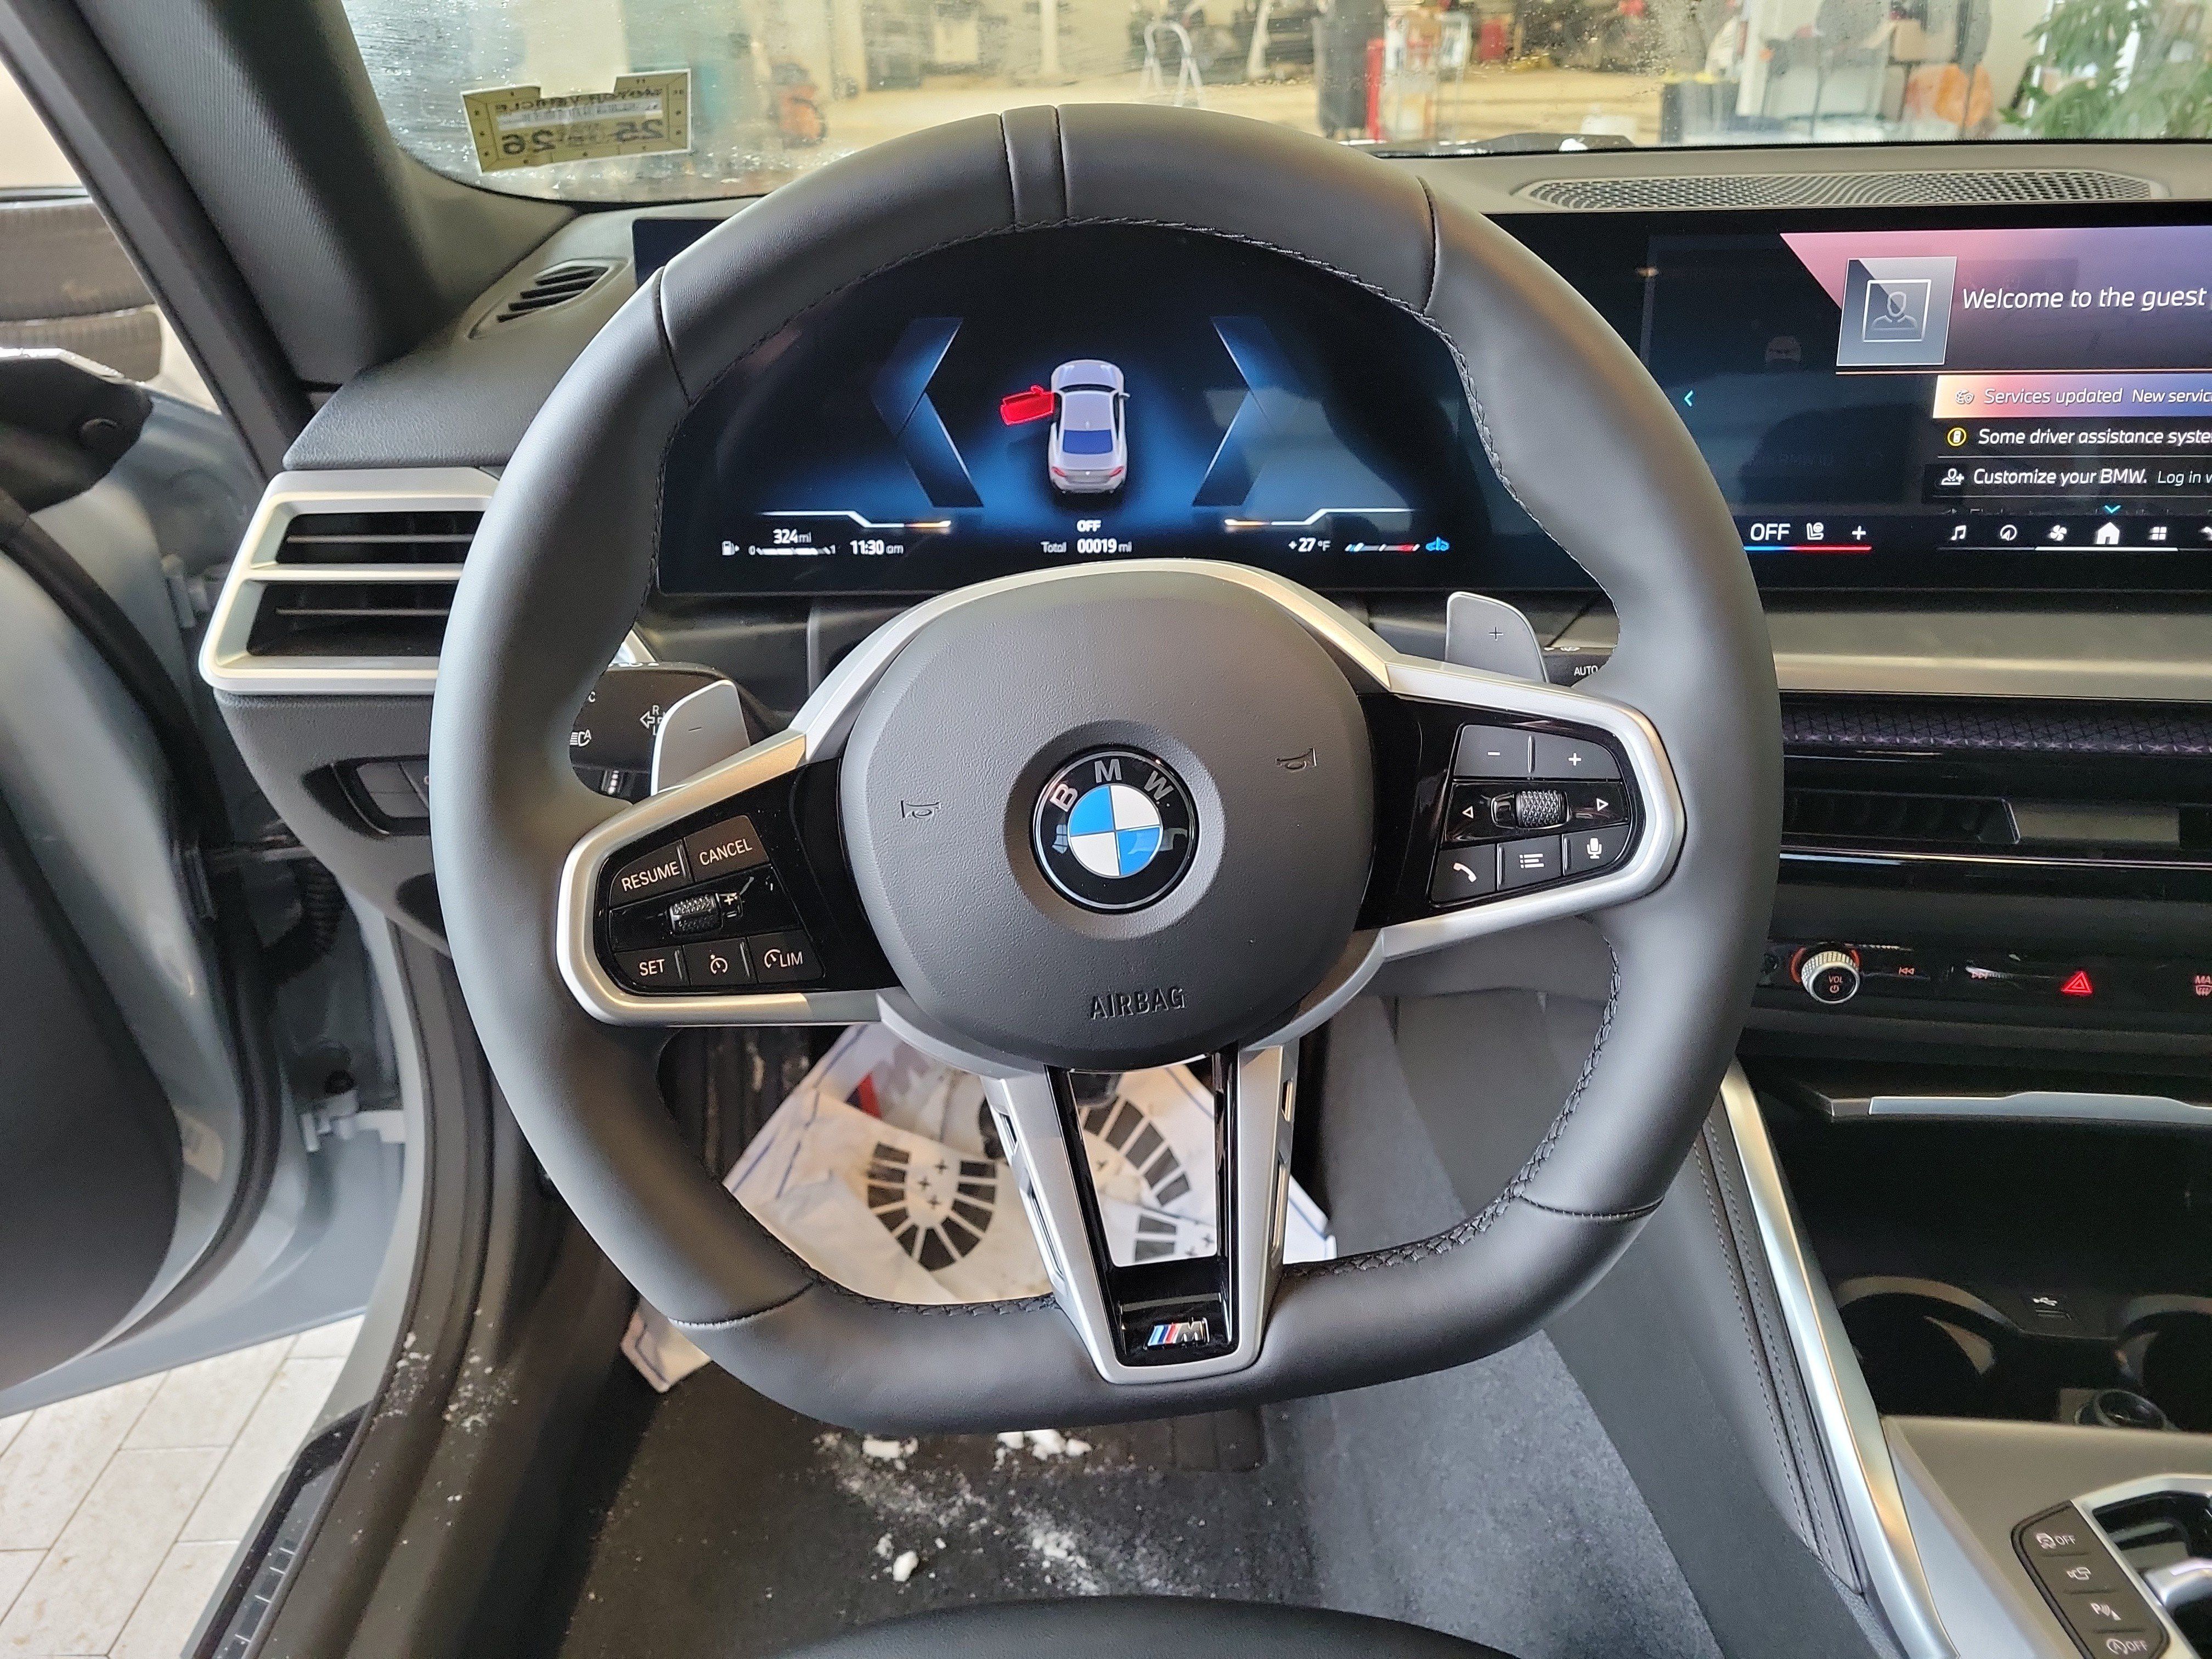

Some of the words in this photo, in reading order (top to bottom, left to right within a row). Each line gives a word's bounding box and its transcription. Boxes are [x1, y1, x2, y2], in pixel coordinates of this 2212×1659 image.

[1962, 288, 2063, 309] Welcome
[2070, 289, 2092, 308] to
[2099, 286, 2135, 307] the
[2141, 287, 2208, 312] guest
[1984, 388, 2051, 404] Services
[2056, 388, 2123, 407] updated
[2132, 389, 2165, 403] New
[2168, 388, 2212, 403] servic
[1978, 428, 2024, 444] Some
[2030, 428, 2075, 444] driver
[2078, 428, 2163, 444] assistance
[2167, 429, 2212, 447] syste
[1974, 468, 2056, 485] Customize
[2060, 471, 2097, 487] your
[2101, 469, 2147, 484] BMW.
[2158, 470, 2185, 486] Log
[2188, 470, 2202, 483] in
[1076, 520, 1102, 532] OFF
[1750, 523, 1791, 541] OFF
[850, 539, 884, 555] 11:30
[885, 544, 904, 554] am
[1040, 541, 1067, 553] Total
[1077, 538, 1117, 553] 00019
[1288, 537, 1316, 552] +27
[1573, 665, 1598, 676] AUTO
[1049, 758, 1175, 813] BMW
[699, 838, 753, 866] CANCEL
[621, 861, 680, 891] RESUME
[639, 959, 665, 976] SET
[780, 952, 803, 967] LIM
[1829, 975, 1843, 984] VOL
[2195, 975, 2212, 984] MA
[1090, 988, 1187, 1021] AIRBAG
[2055, 1536, 2075, 1545] OFF
